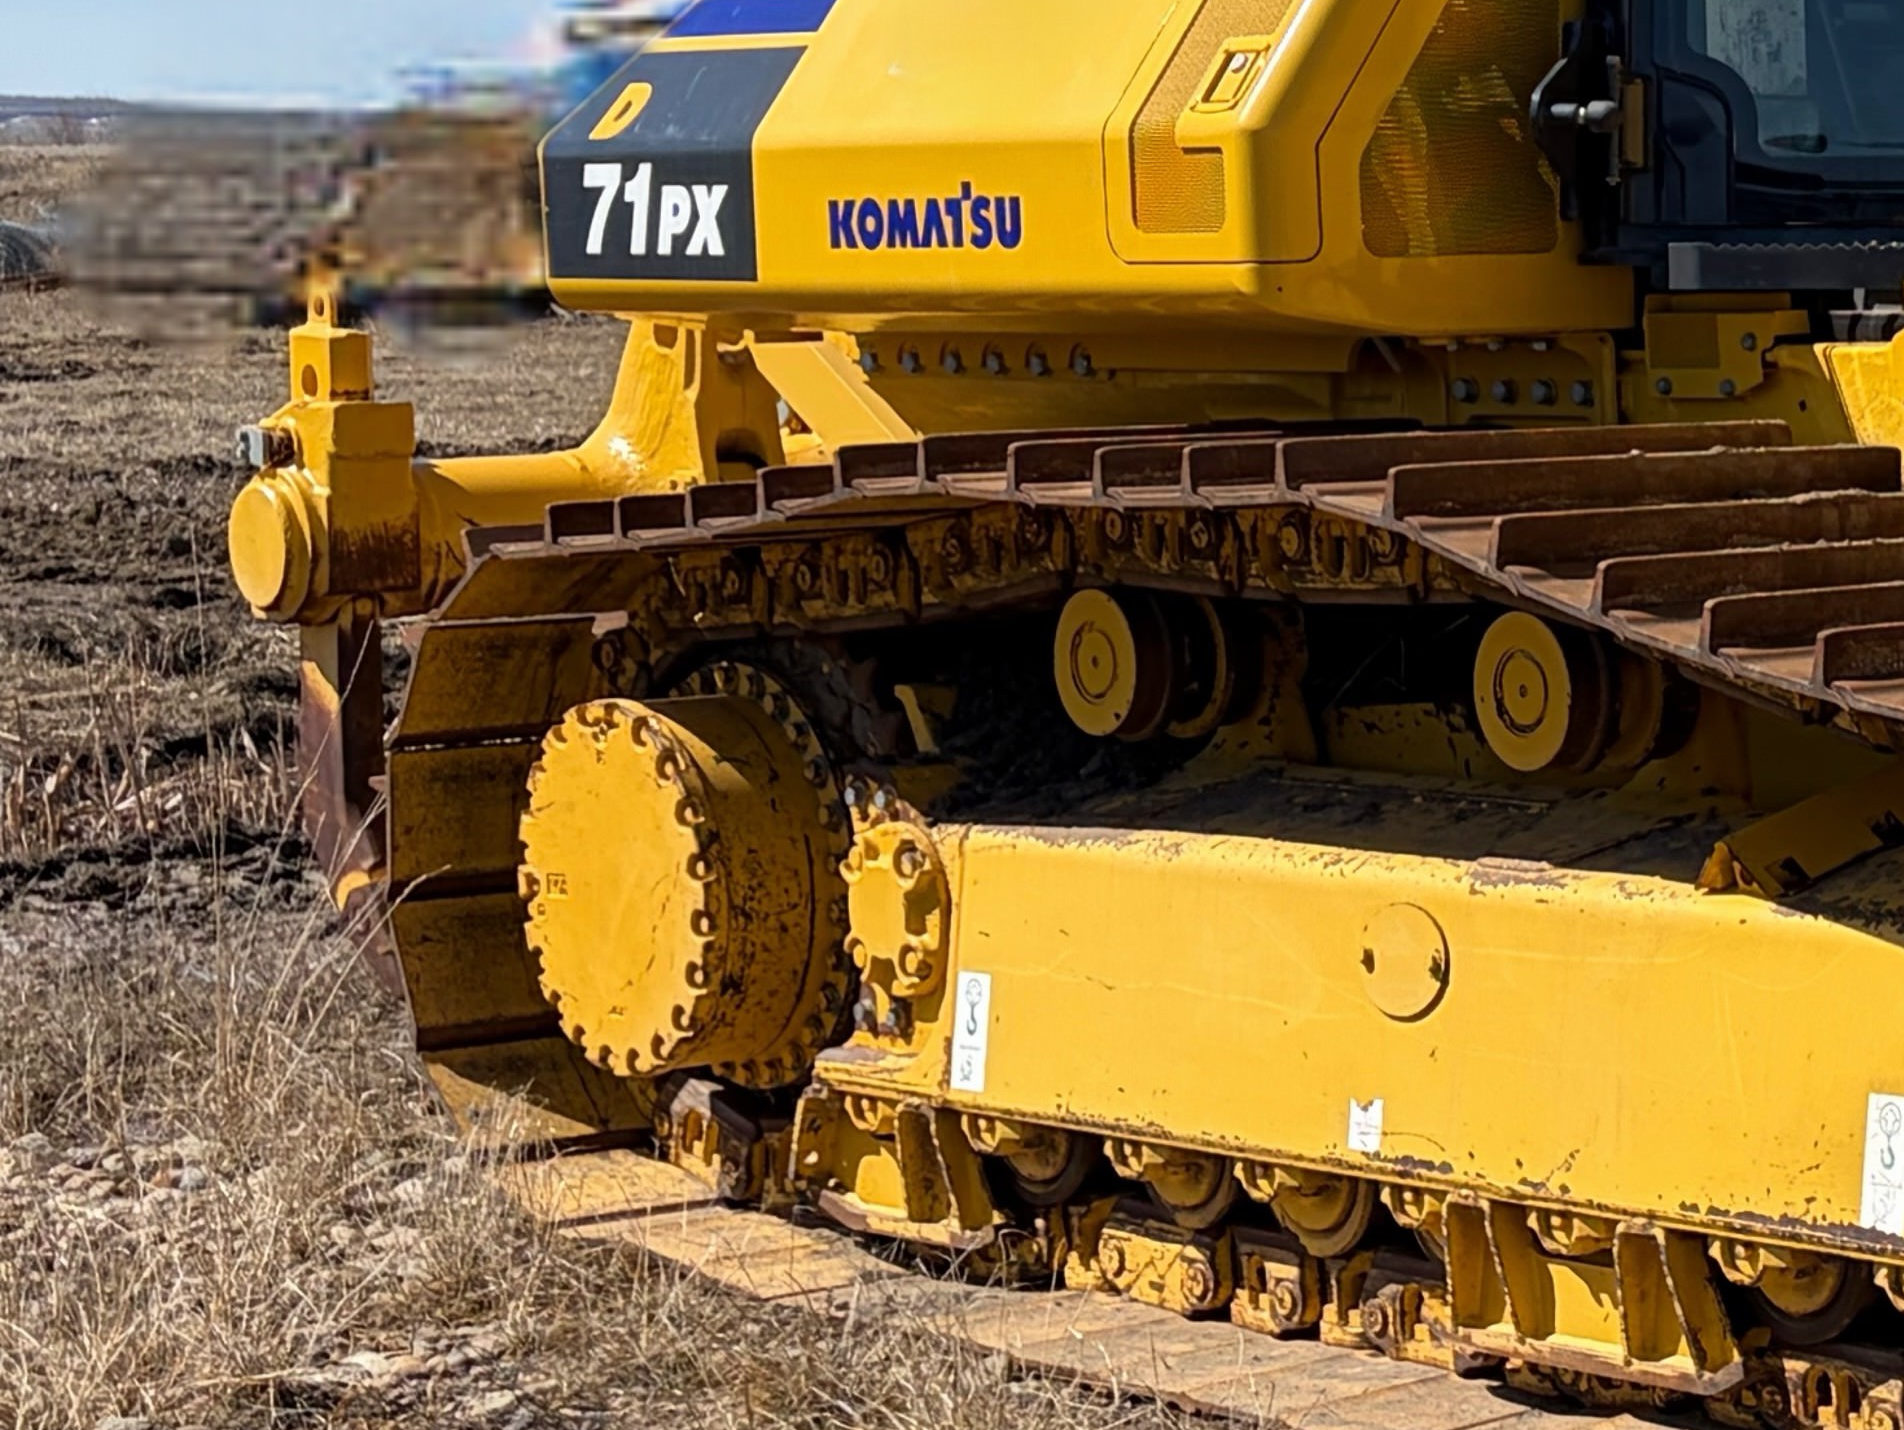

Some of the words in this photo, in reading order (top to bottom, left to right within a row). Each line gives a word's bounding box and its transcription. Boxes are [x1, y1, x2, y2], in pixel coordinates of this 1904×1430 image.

[588, 81, 653, 140] D
[583, 162, 729, 256] 71PX
[828, 181, 1021, 250] KOMATSU
